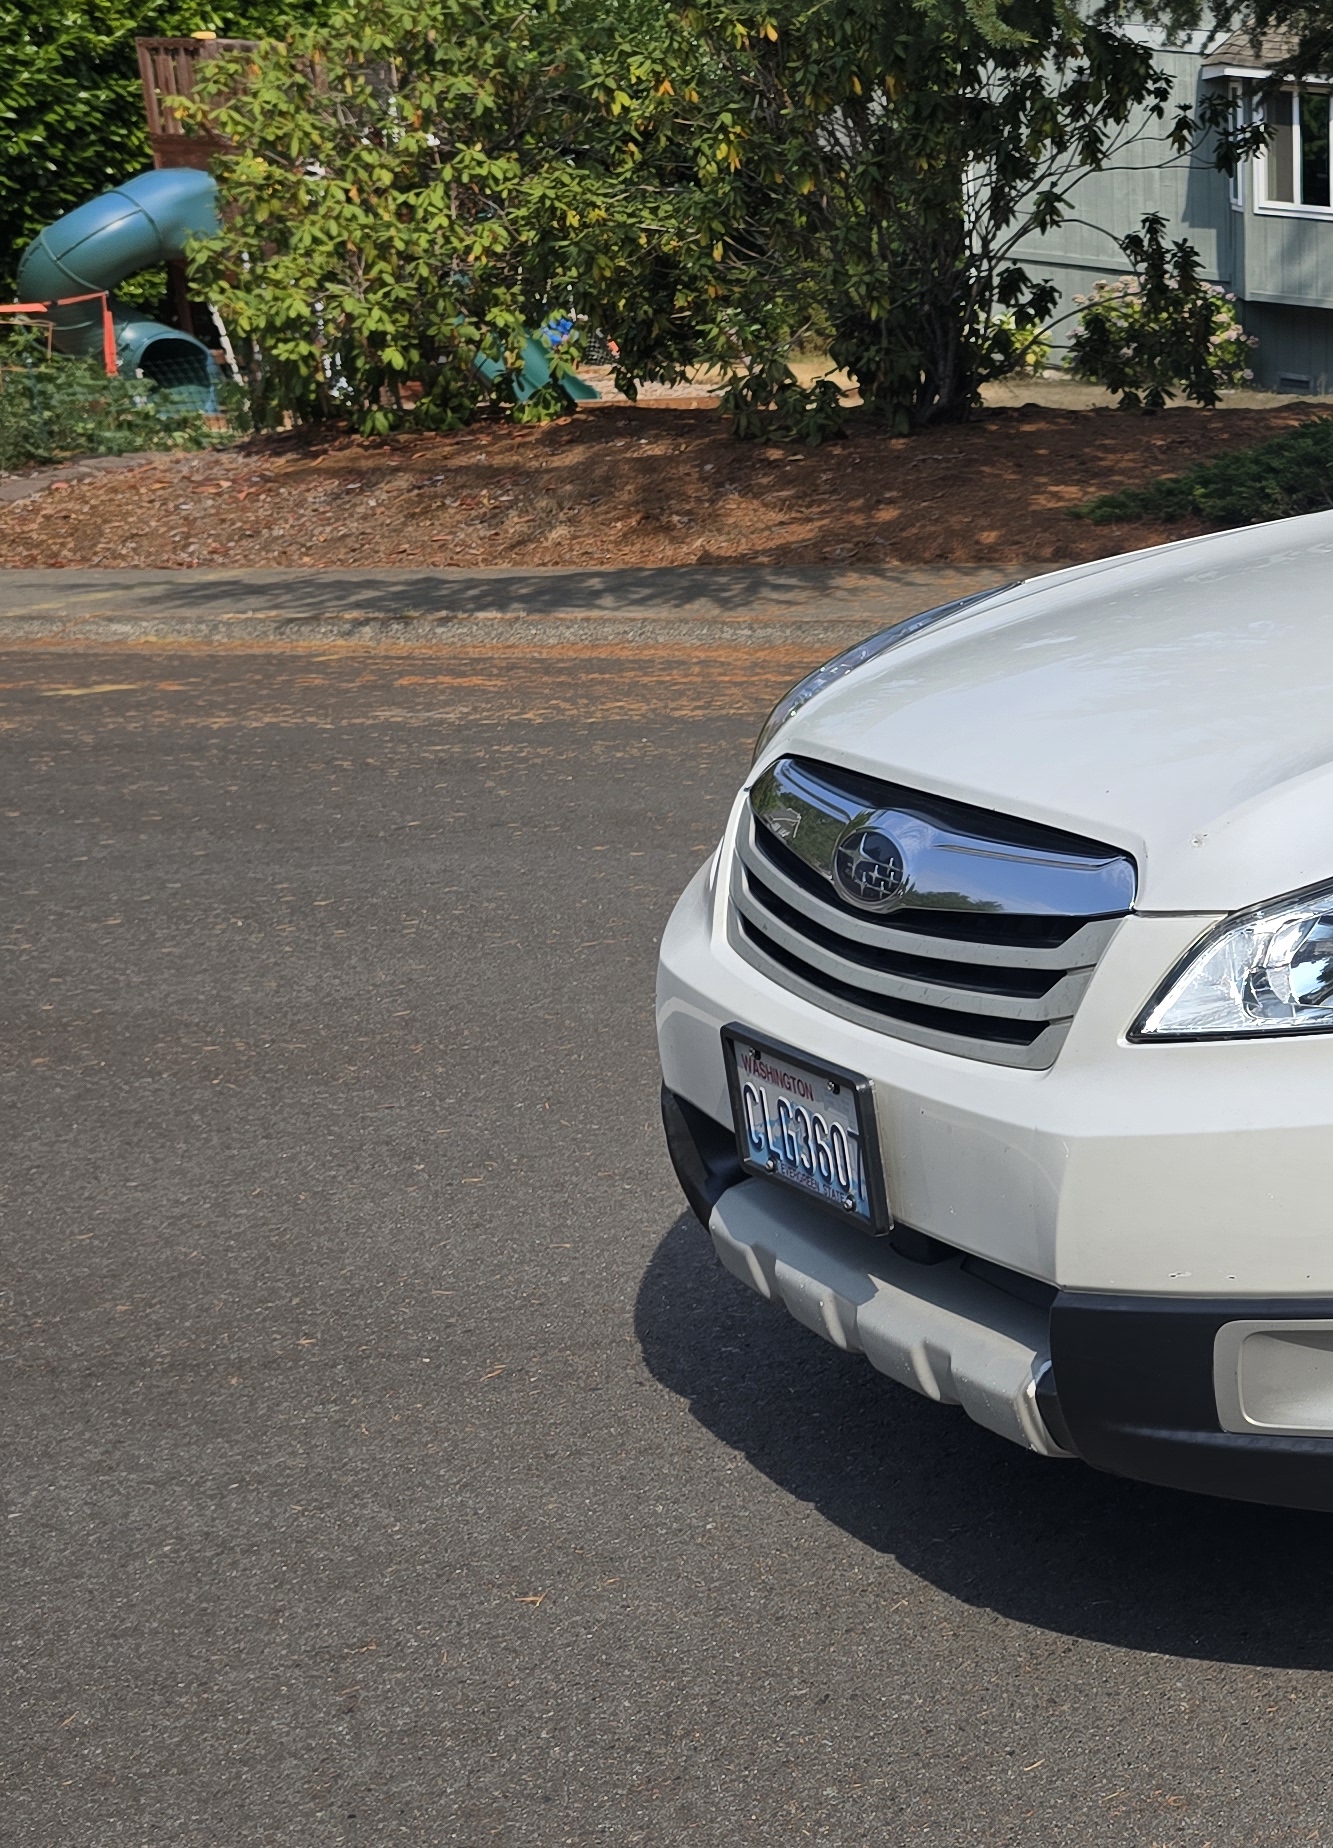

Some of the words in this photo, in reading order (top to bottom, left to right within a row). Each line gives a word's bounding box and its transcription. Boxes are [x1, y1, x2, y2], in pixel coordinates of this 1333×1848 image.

[741, 1053, 815, 1102] WASHINGTON
[781, 1162, 820, 1192] EVERGREEN
[823, 1184, 846, 1203] STATE
